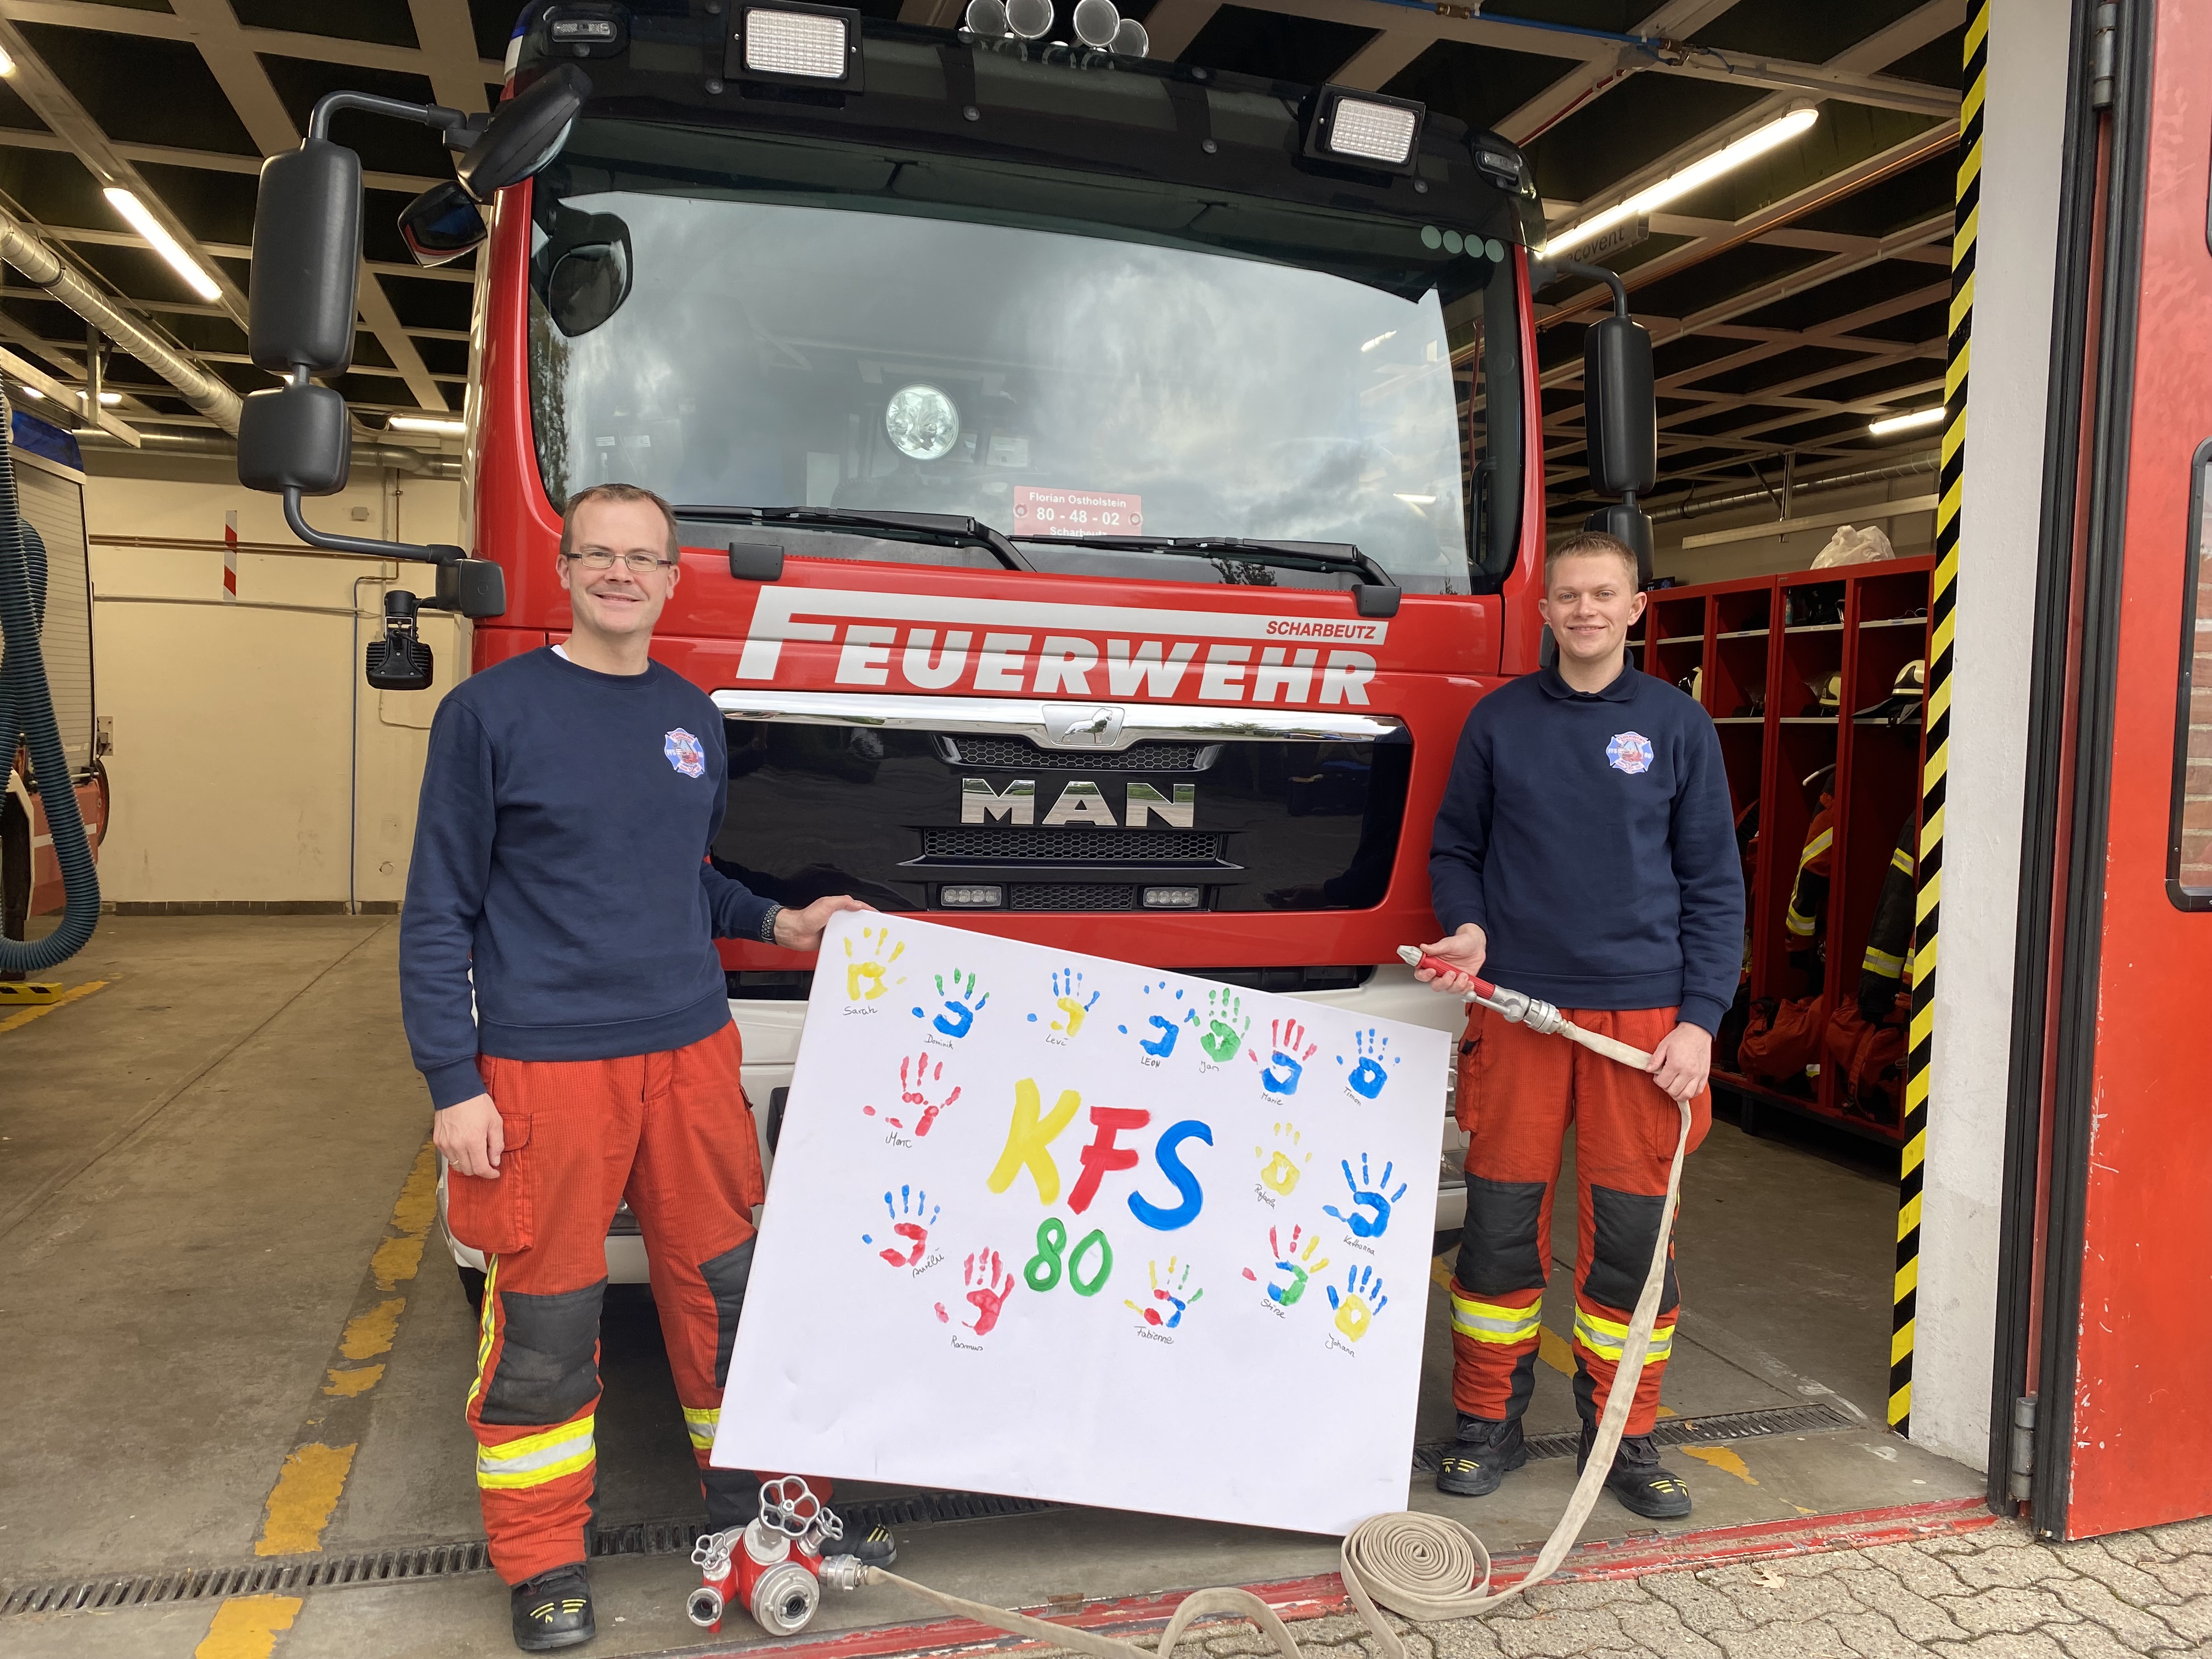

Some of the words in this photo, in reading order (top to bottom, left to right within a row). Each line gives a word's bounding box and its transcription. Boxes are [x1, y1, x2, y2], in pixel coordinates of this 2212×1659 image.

[1029, 492, 1065, 504] Florian
[1068, 495, 1126, 508] Ostholstein
[1036, 507, 1054, 521] 80
[1069, 509, 1087, 523] 48
[1102, 511, 1120, 526] 02
[1266, 620, 1376, 640] SCHARBEUTZ
[736, 585, 1389, 706] FEUERWEHR
[960, 778, 1195, 830] MAN
[843, 1006, 877, 1016] Sarah
[924, 1034, 953, 1050] Dominik
[1046, 1034, 1068, 1046] Levi
[1141, 1056, 1161, 1068] LEON
[1199, 1060, 1220, 1074] Jan
[1261, 1092, 1284, 1105] Marie
[1344, 1086, 1362, 1107] Timon
[885, 1131, 912, 1148] Marc
[986, 1077, 1214, 1232] KFS
[1255, 1183, 1276, 1210] Rafaela
[1343, 1234, 1375, 1256] Katharina
[1024, 1217, 1113, 1297] 80
[951, 1335, 984, 1351] Rasmus
[1134, 1325, 1175, 1345] Fabienne
[1325, 1333, 1355, 1358] Johann
